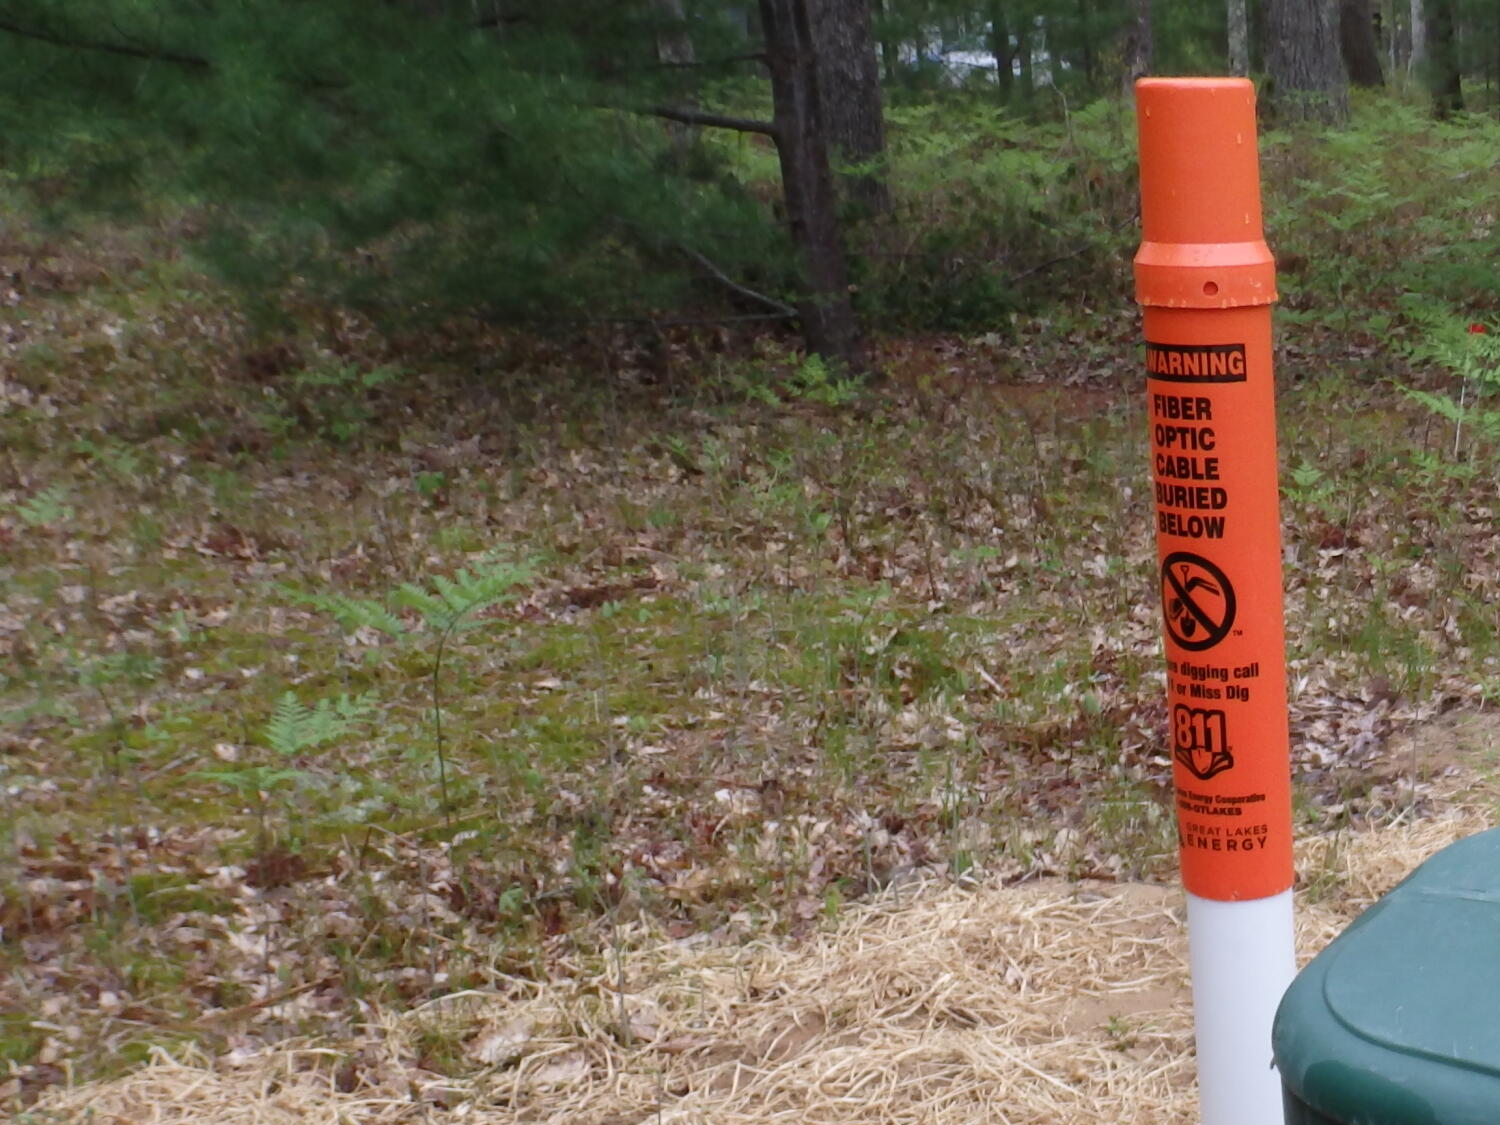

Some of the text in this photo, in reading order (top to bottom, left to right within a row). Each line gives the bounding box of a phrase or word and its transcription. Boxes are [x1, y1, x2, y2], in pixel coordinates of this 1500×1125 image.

[1146, 350, 1245, 376] WARNING
[1153, 394, 1212, 420] FIBER
[1155, 424, 1215, 450] OPTIC
[1156, 453, 1219, 480] CABLE
[1155, 482, 1227, 510] BURIED
[1159, 511, 1225, 539] BELOW
[1181, 662, 1228, 682] digging
[1233, 662, 1259, 679] call
[1177, 684, 1186, 696] or
[1189, 683, 1221, 699] Miss
[1226, 685, 1249, 702] Dig
[1175, 704, 1225, 753] 811
[1186, 822, 1268, 837] GREAT LAKES
[1187, 834, 1267, 851] ENERGY
